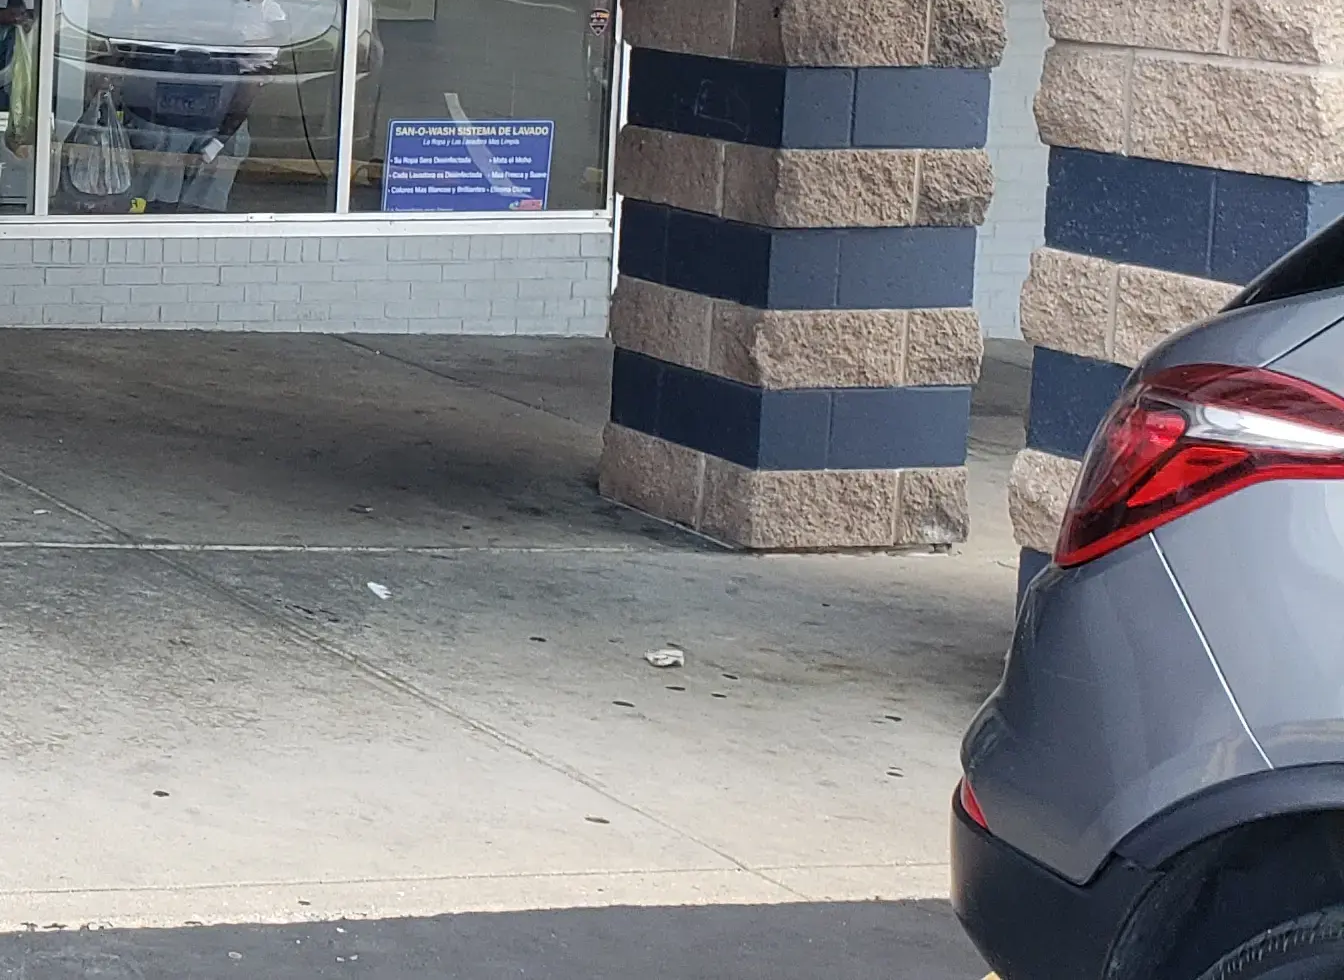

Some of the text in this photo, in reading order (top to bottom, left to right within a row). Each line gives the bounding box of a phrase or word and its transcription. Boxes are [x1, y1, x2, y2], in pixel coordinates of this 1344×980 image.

[395, 126, 549, 137] SAN-O-WASH SISTEMA DE LAVADO
